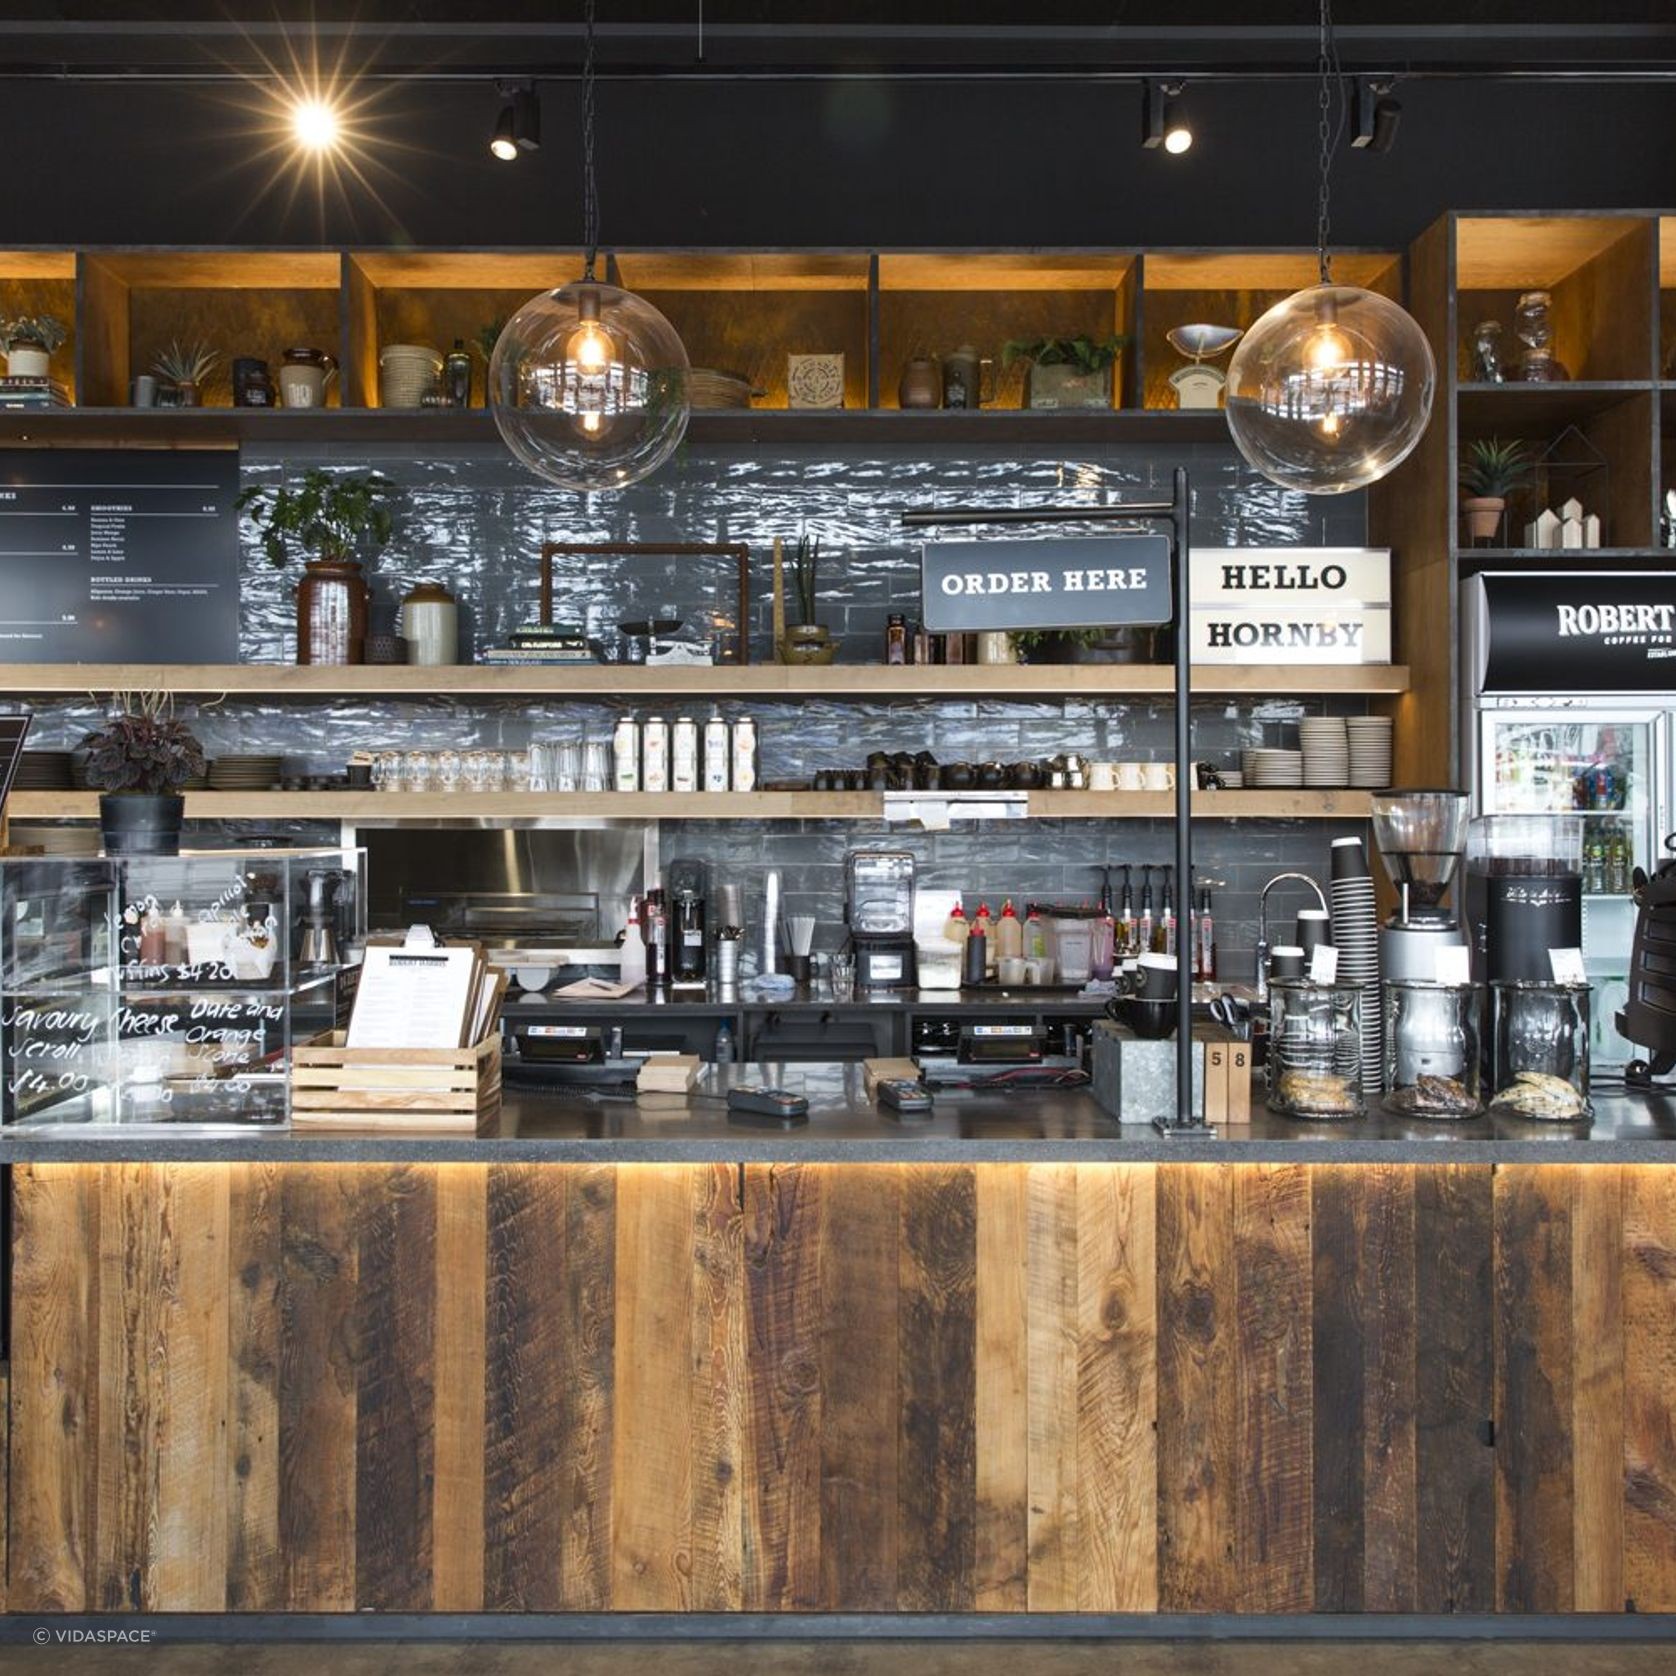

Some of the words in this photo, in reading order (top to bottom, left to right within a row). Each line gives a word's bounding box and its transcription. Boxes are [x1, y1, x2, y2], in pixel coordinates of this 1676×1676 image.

[941, 570, 1053, 597] ORDER
[1063, 567, 1148, 592] HERE
[1221, 564, 1348, 590] HELLO
[1556, 604, 1675, 637] ROBERT
[1207, 622, 1364, 648] HORNBY
[1604, 635, 1646, 645] COFFEE
[1, 1006, 99, 1042] Savoury
[108, 1006, 179, 1036] Cheese
[8, 1037, 82, 1060] Scroll
[185, 1026, 267, 1048] Orange
[1211, 1052, 1222, 1066] 5
[1235, 1052, 1245, 1067] 8
